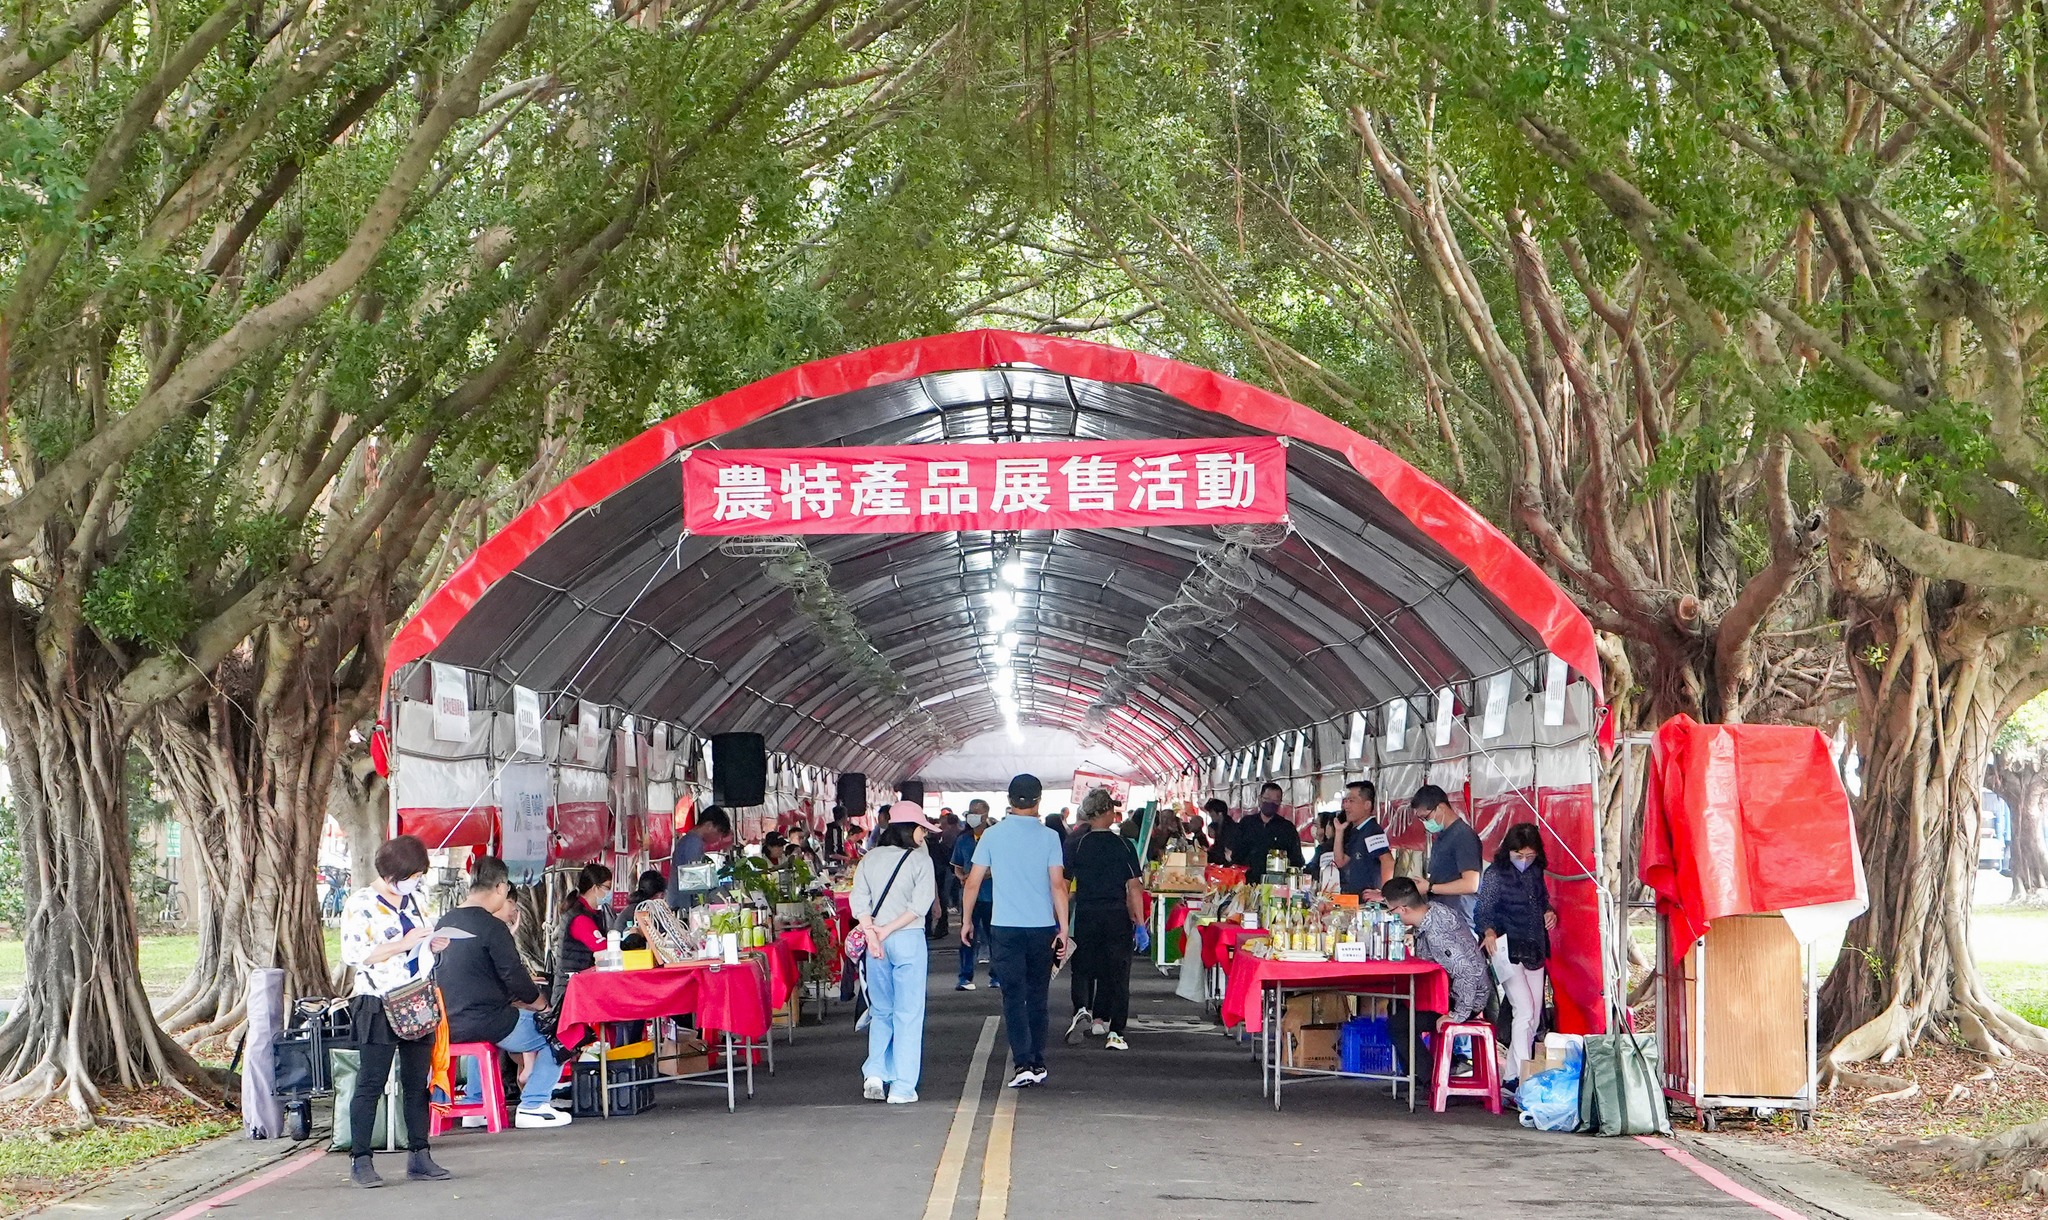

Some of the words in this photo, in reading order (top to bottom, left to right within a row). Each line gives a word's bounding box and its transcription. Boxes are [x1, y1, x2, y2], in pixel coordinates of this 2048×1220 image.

[712, 452, 1257, 522] 農特產品展售活動
